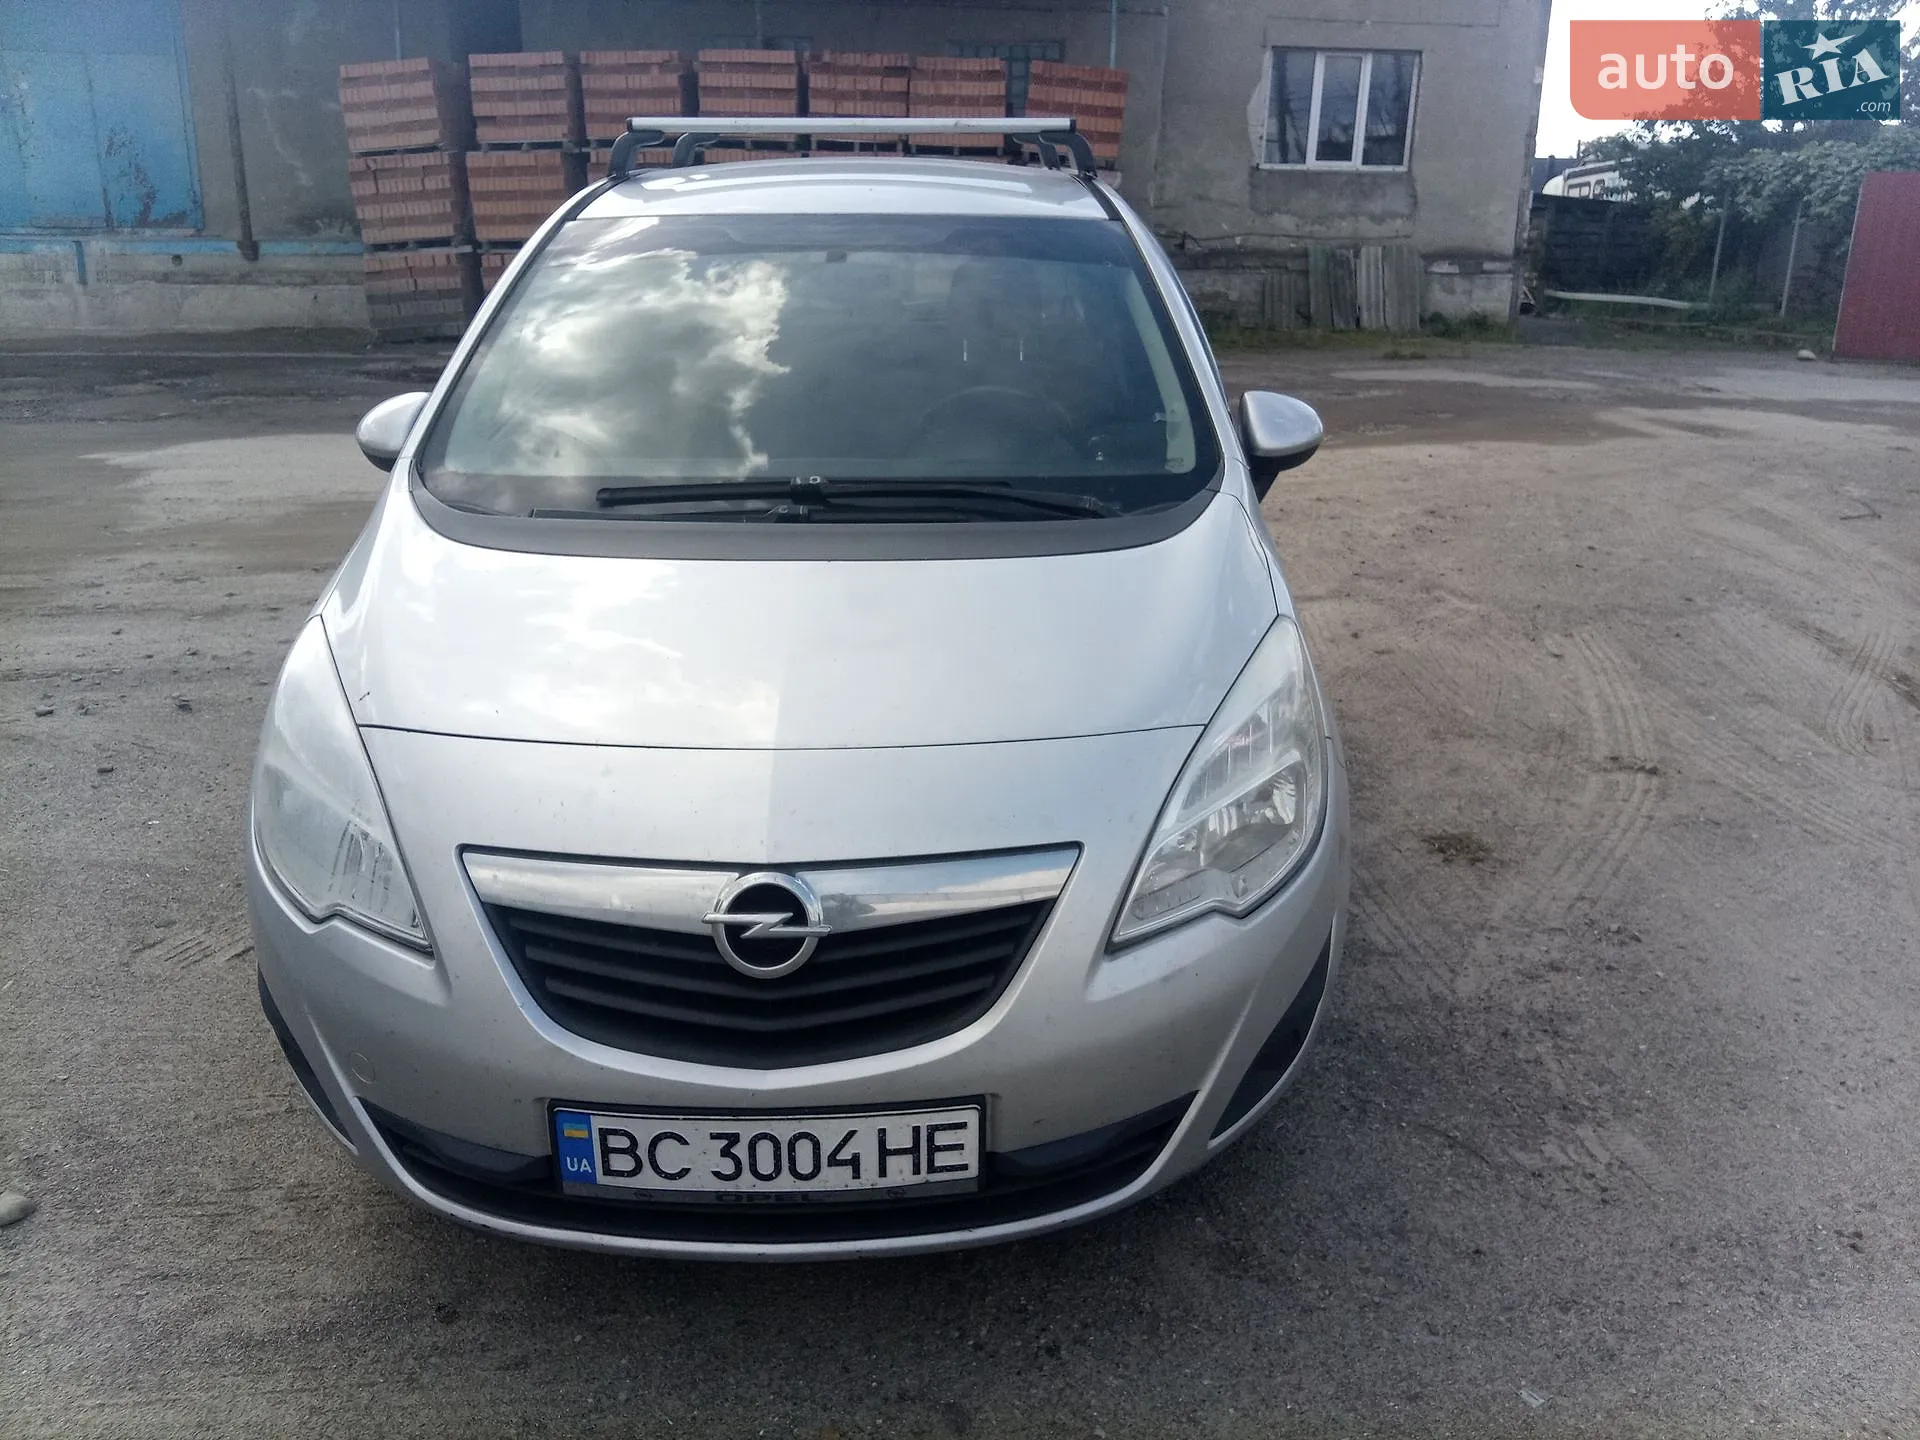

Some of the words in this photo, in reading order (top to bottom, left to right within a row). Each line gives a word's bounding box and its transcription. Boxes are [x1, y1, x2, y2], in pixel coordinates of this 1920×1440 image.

[566, 1156, 592, 1175] UA
[598, 1126, 692, 1181] BC
[709, 1129, 861, 1183] 3004
[877, 1121, 969, 1179] HE
